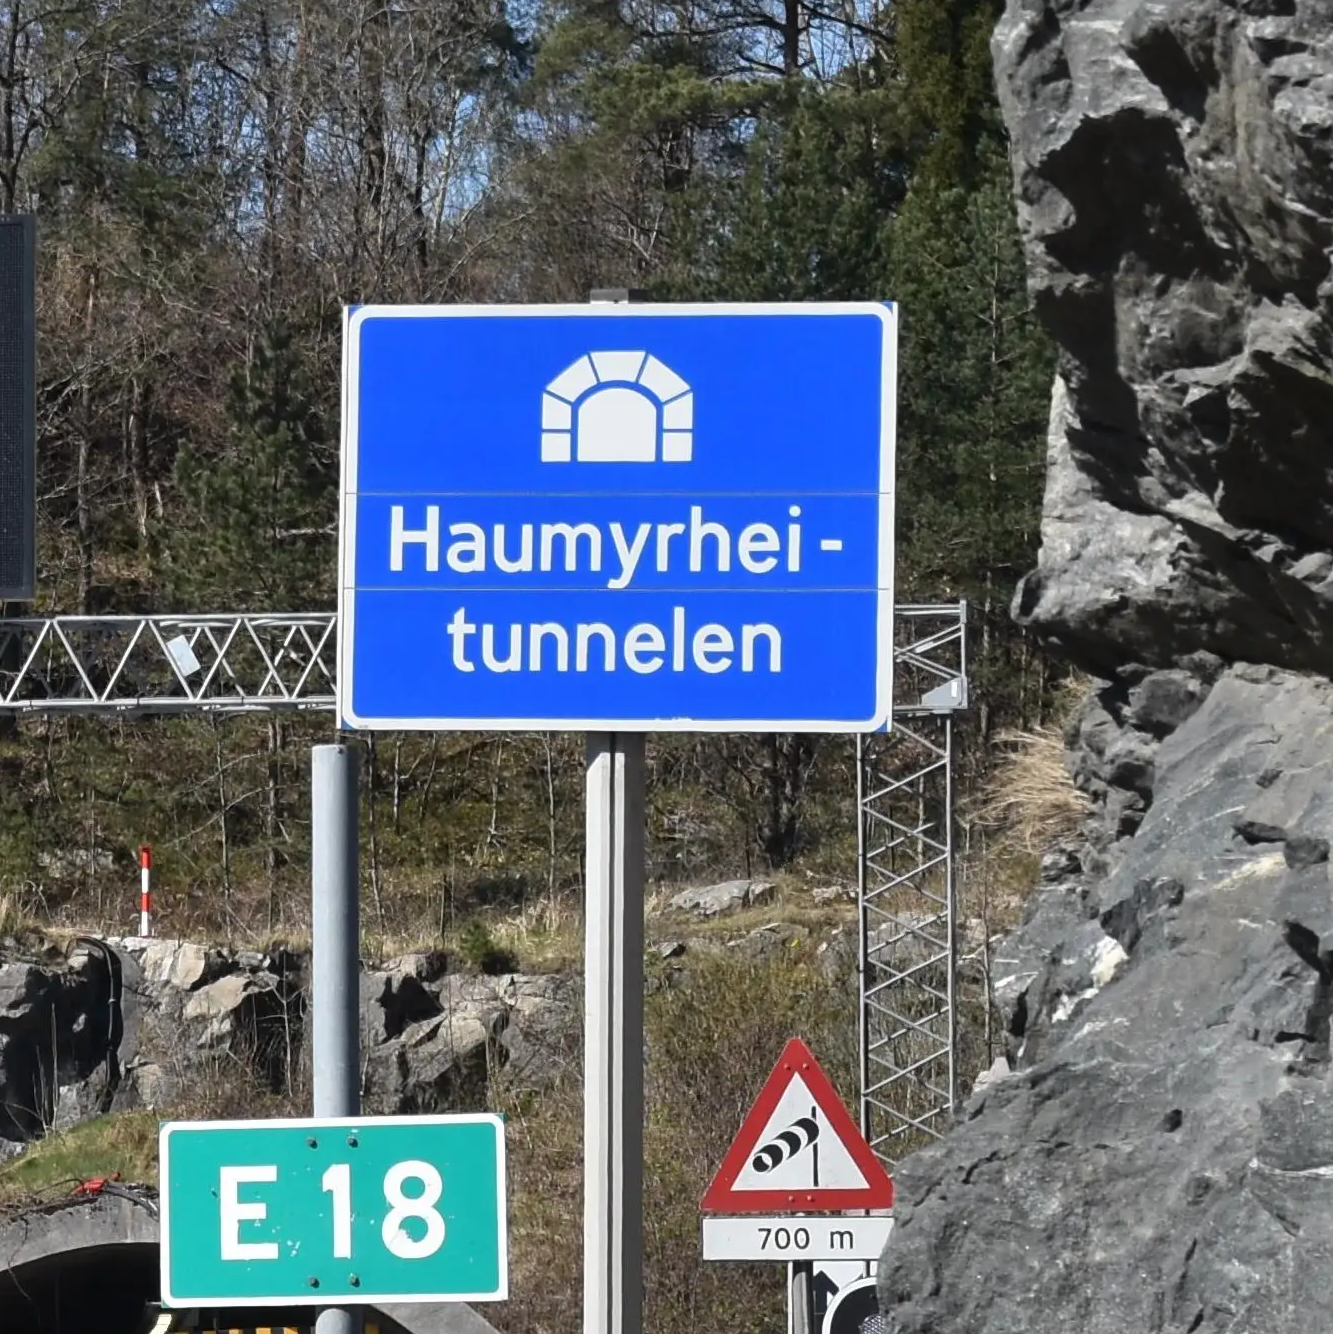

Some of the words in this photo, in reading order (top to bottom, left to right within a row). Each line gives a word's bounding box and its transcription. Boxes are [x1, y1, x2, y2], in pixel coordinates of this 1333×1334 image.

[446, 606, 783, 674] tunnelen
[219, 1165, 279, 1261] E
[321, 1160, 446, 1260] 18
[757, 1227, 810, 1250] 700
[829, 1230, 854, 1249] m
